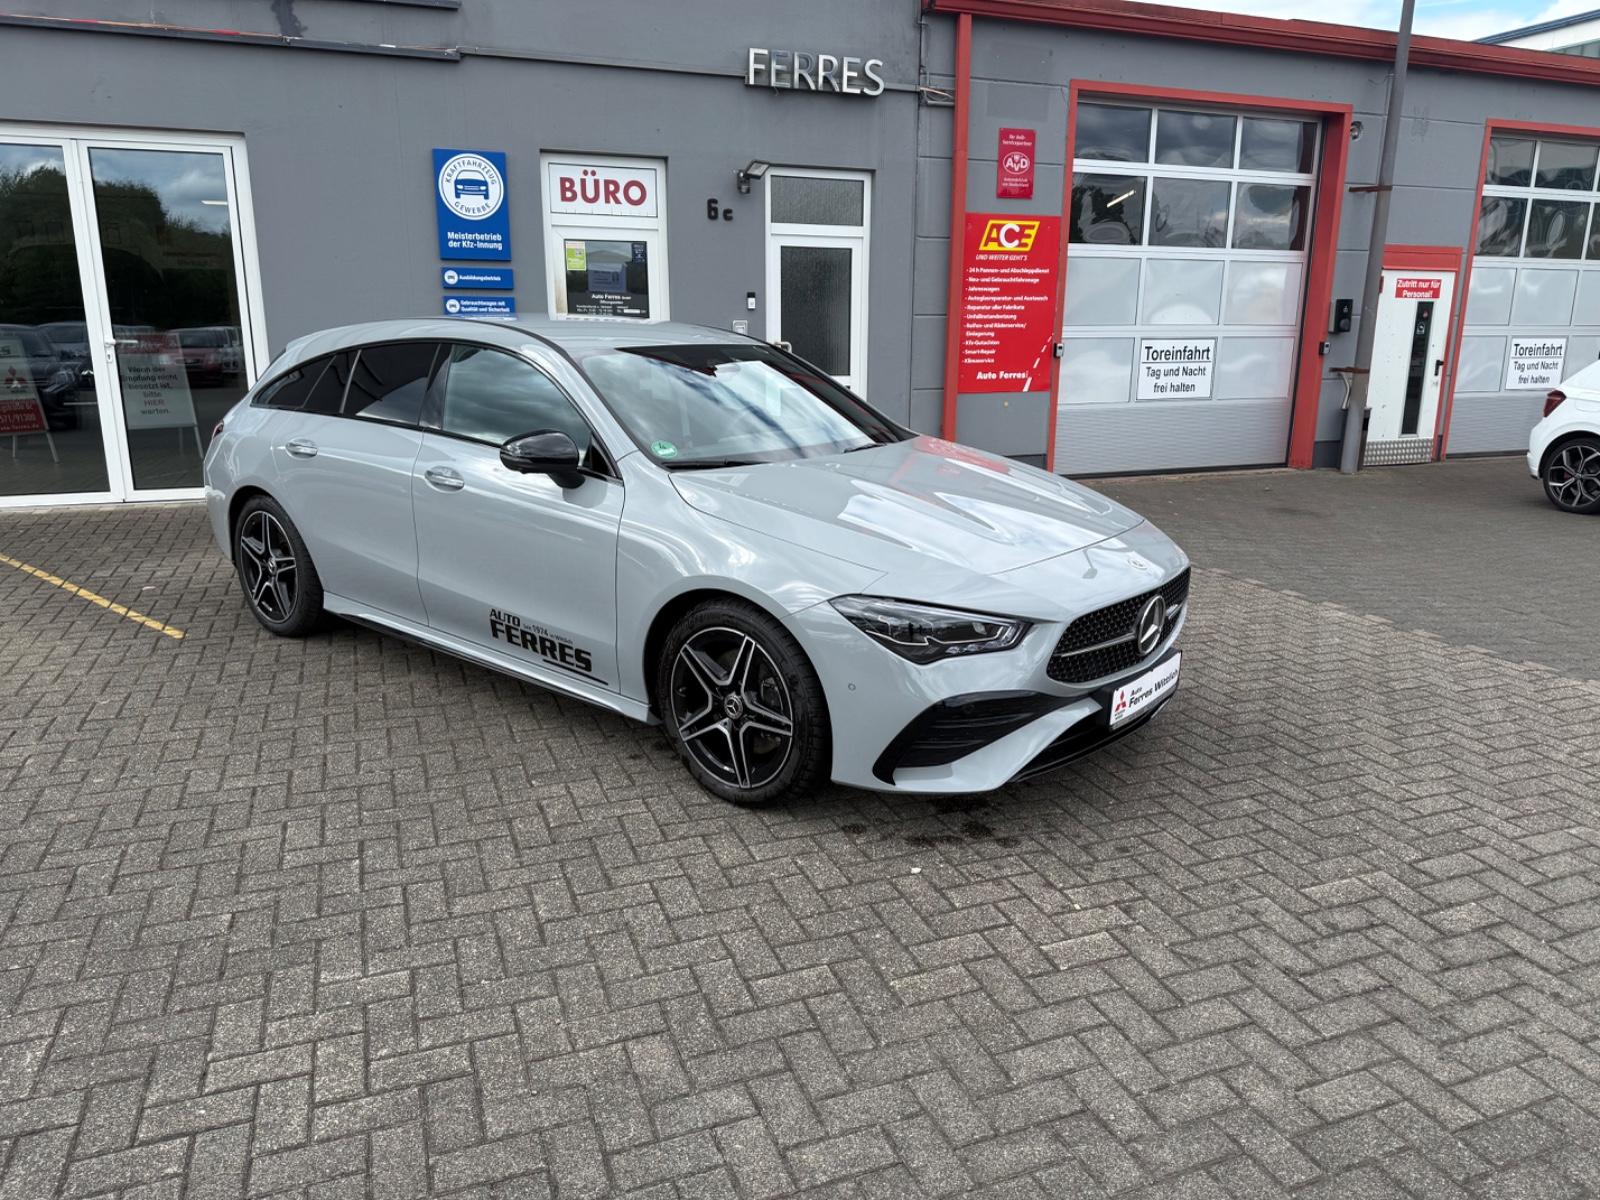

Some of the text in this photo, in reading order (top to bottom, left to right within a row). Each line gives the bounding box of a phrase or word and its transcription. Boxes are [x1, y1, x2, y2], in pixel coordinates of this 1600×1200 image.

[749, 48, 885, 96] FERRES
[445, 159, 498, 185] KRAFTFAHRZEUG
[559, 169, 648, 206] BÜRO
[454, 201, 491, 214] GEWERBE
[447, 231, 503, 241] Meisterbetrieb
[979, 219, 1040, 252] ACE
[462, 241, 503, 251] Kfz-Innung
[1010, 267, 1050, 275] Abschleppdienst
[459, 274, 502, 282] Ausbildungsbetrieb
[1397, 280, 1418, 288] Zutritt
[1430, 280, 1441, 288] für
[1402, 289, 1434, 298] Personal!
[1144, 345, 1211, 361] Toreinfahrt
[1514, 343, 1563, 356] Toreinfahrt
[1146, 365, 1206, 380] Tag und Nacht
[1514, 360, 1559, 373] Tag und Nacht
[976, 371, 997, 380] Auto
[1518, 374, 1551, 384] frei halten
[1153, 381, 1196, 393] frei halten
[489, 608, 521, 627] AUTO
[489, 618, 592, 672] FERRES
[1129, 669, 1178, 707] Ferres Wittlich
[1131, 687, 1142, 696] Auto
